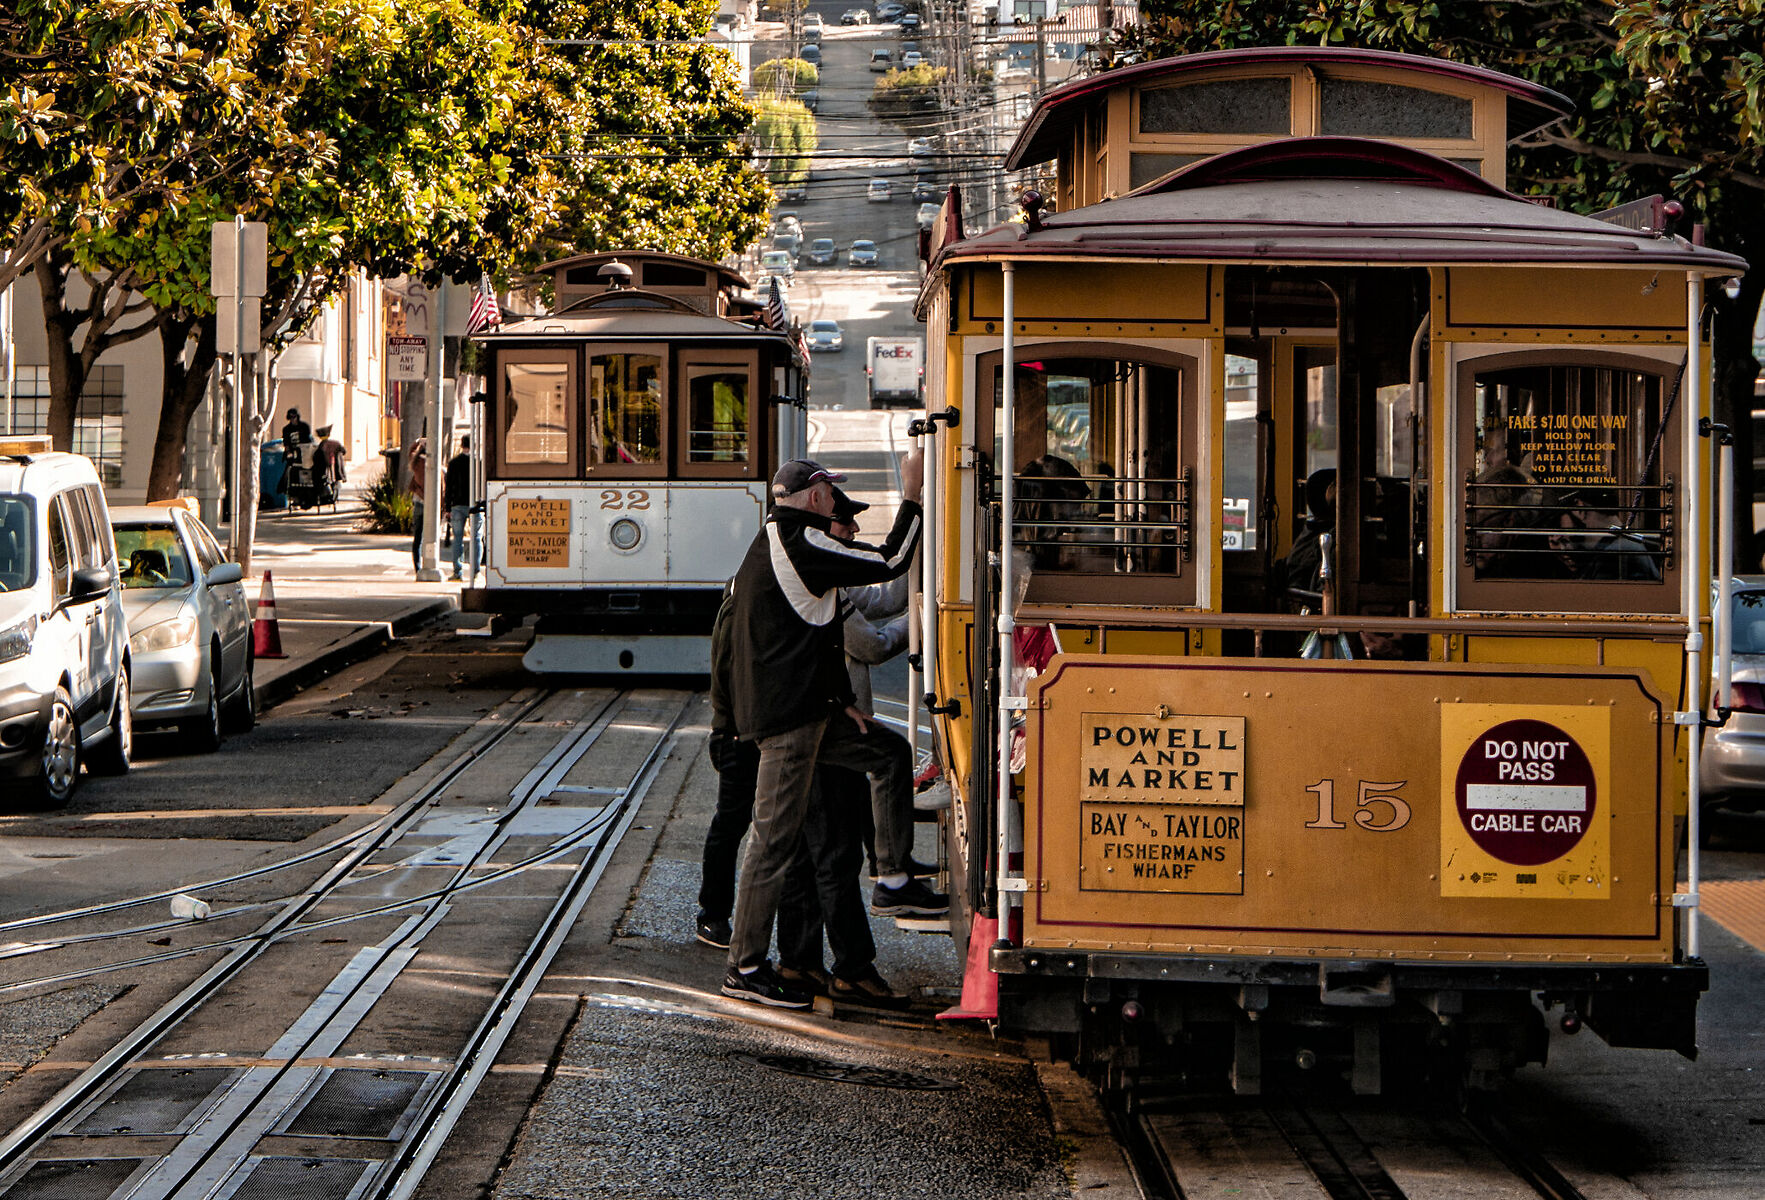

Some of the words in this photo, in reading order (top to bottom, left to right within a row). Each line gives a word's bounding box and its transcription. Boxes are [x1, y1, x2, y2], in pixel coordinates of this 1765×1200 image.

[875, 346, 912, 358] FedEx
[399, 364, 415, 372] TIME
[1508, 415, 1537, 430] FARE
[1571, 415, 1598, 429] ONE
[1602, 415, 1628, 429] WAY
[1545, 432, 1573, 440] HOLD
[1575, 432, 1591, 440] ON
[1520, 443, 1543, 451] KEEP
[1545, 443, 1583, 451] YELLOW
[1585, 443, 1616, 451] FLOOR
[1567, 454, 1601, 462] CLEAR
[1551, 465, 1608, 473] TRANSFERS
[1568, 476, 1583, 484] OR
[1586, 476, 1617, 484] DRINK
[511, 502, 567, 511] POWELL
[600, 489, 650, 510] 22
[510, 519, 567, 527] MARKET
[509, 537, 524, 547] BAY
[538, 537, 567, 547] TAYLOR
[514, 548, 562, 556] FISHERMANS
[1093, 726, 1237, 750] POWELL
[1485, 740, 1518, 759] DO
[1522, 741, 1569, 760] NOT
[1130, 750, 1200, 766] AND
[1499, 761, 1555, 781] PASS
[1088, 768, 1238, 791] MARKET
[1305, 779, 1412, 832] 15
[1091, 812, 1128, 836] BAY
[1164, 814, 1240, 839] TAYLOR
[1470, 814, 1535, 832] CABLE
[1541, 815, 1582, 833] CAR
[1104, 843, 1226, 862] FISHERMANS
[1133, 863, 1196, 879] WHARF
